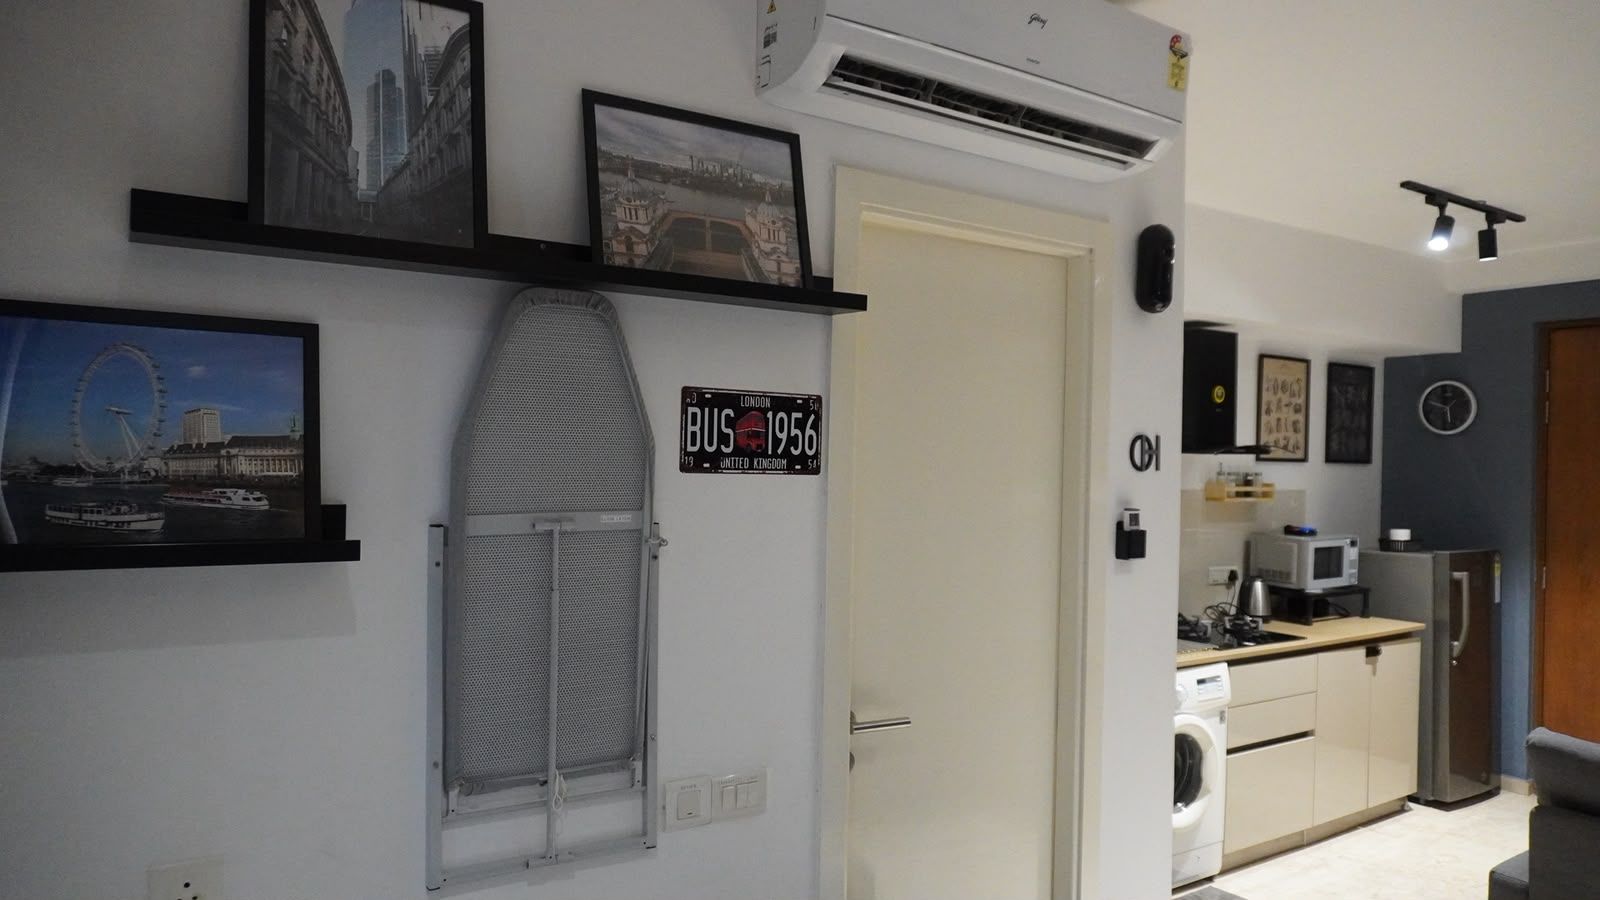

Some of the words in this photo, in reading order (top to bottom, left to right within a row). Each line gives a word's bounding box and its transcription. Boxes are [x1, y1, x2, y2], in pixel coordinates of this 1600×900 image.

[740, 395, 771, 408] LONDON
[687, 406, 735, 453] BUS
[766, 411, 817, 456] 1956
[720, 457, 749, 468] UNITED
[753, 458, 787, 469] KINGDOM
